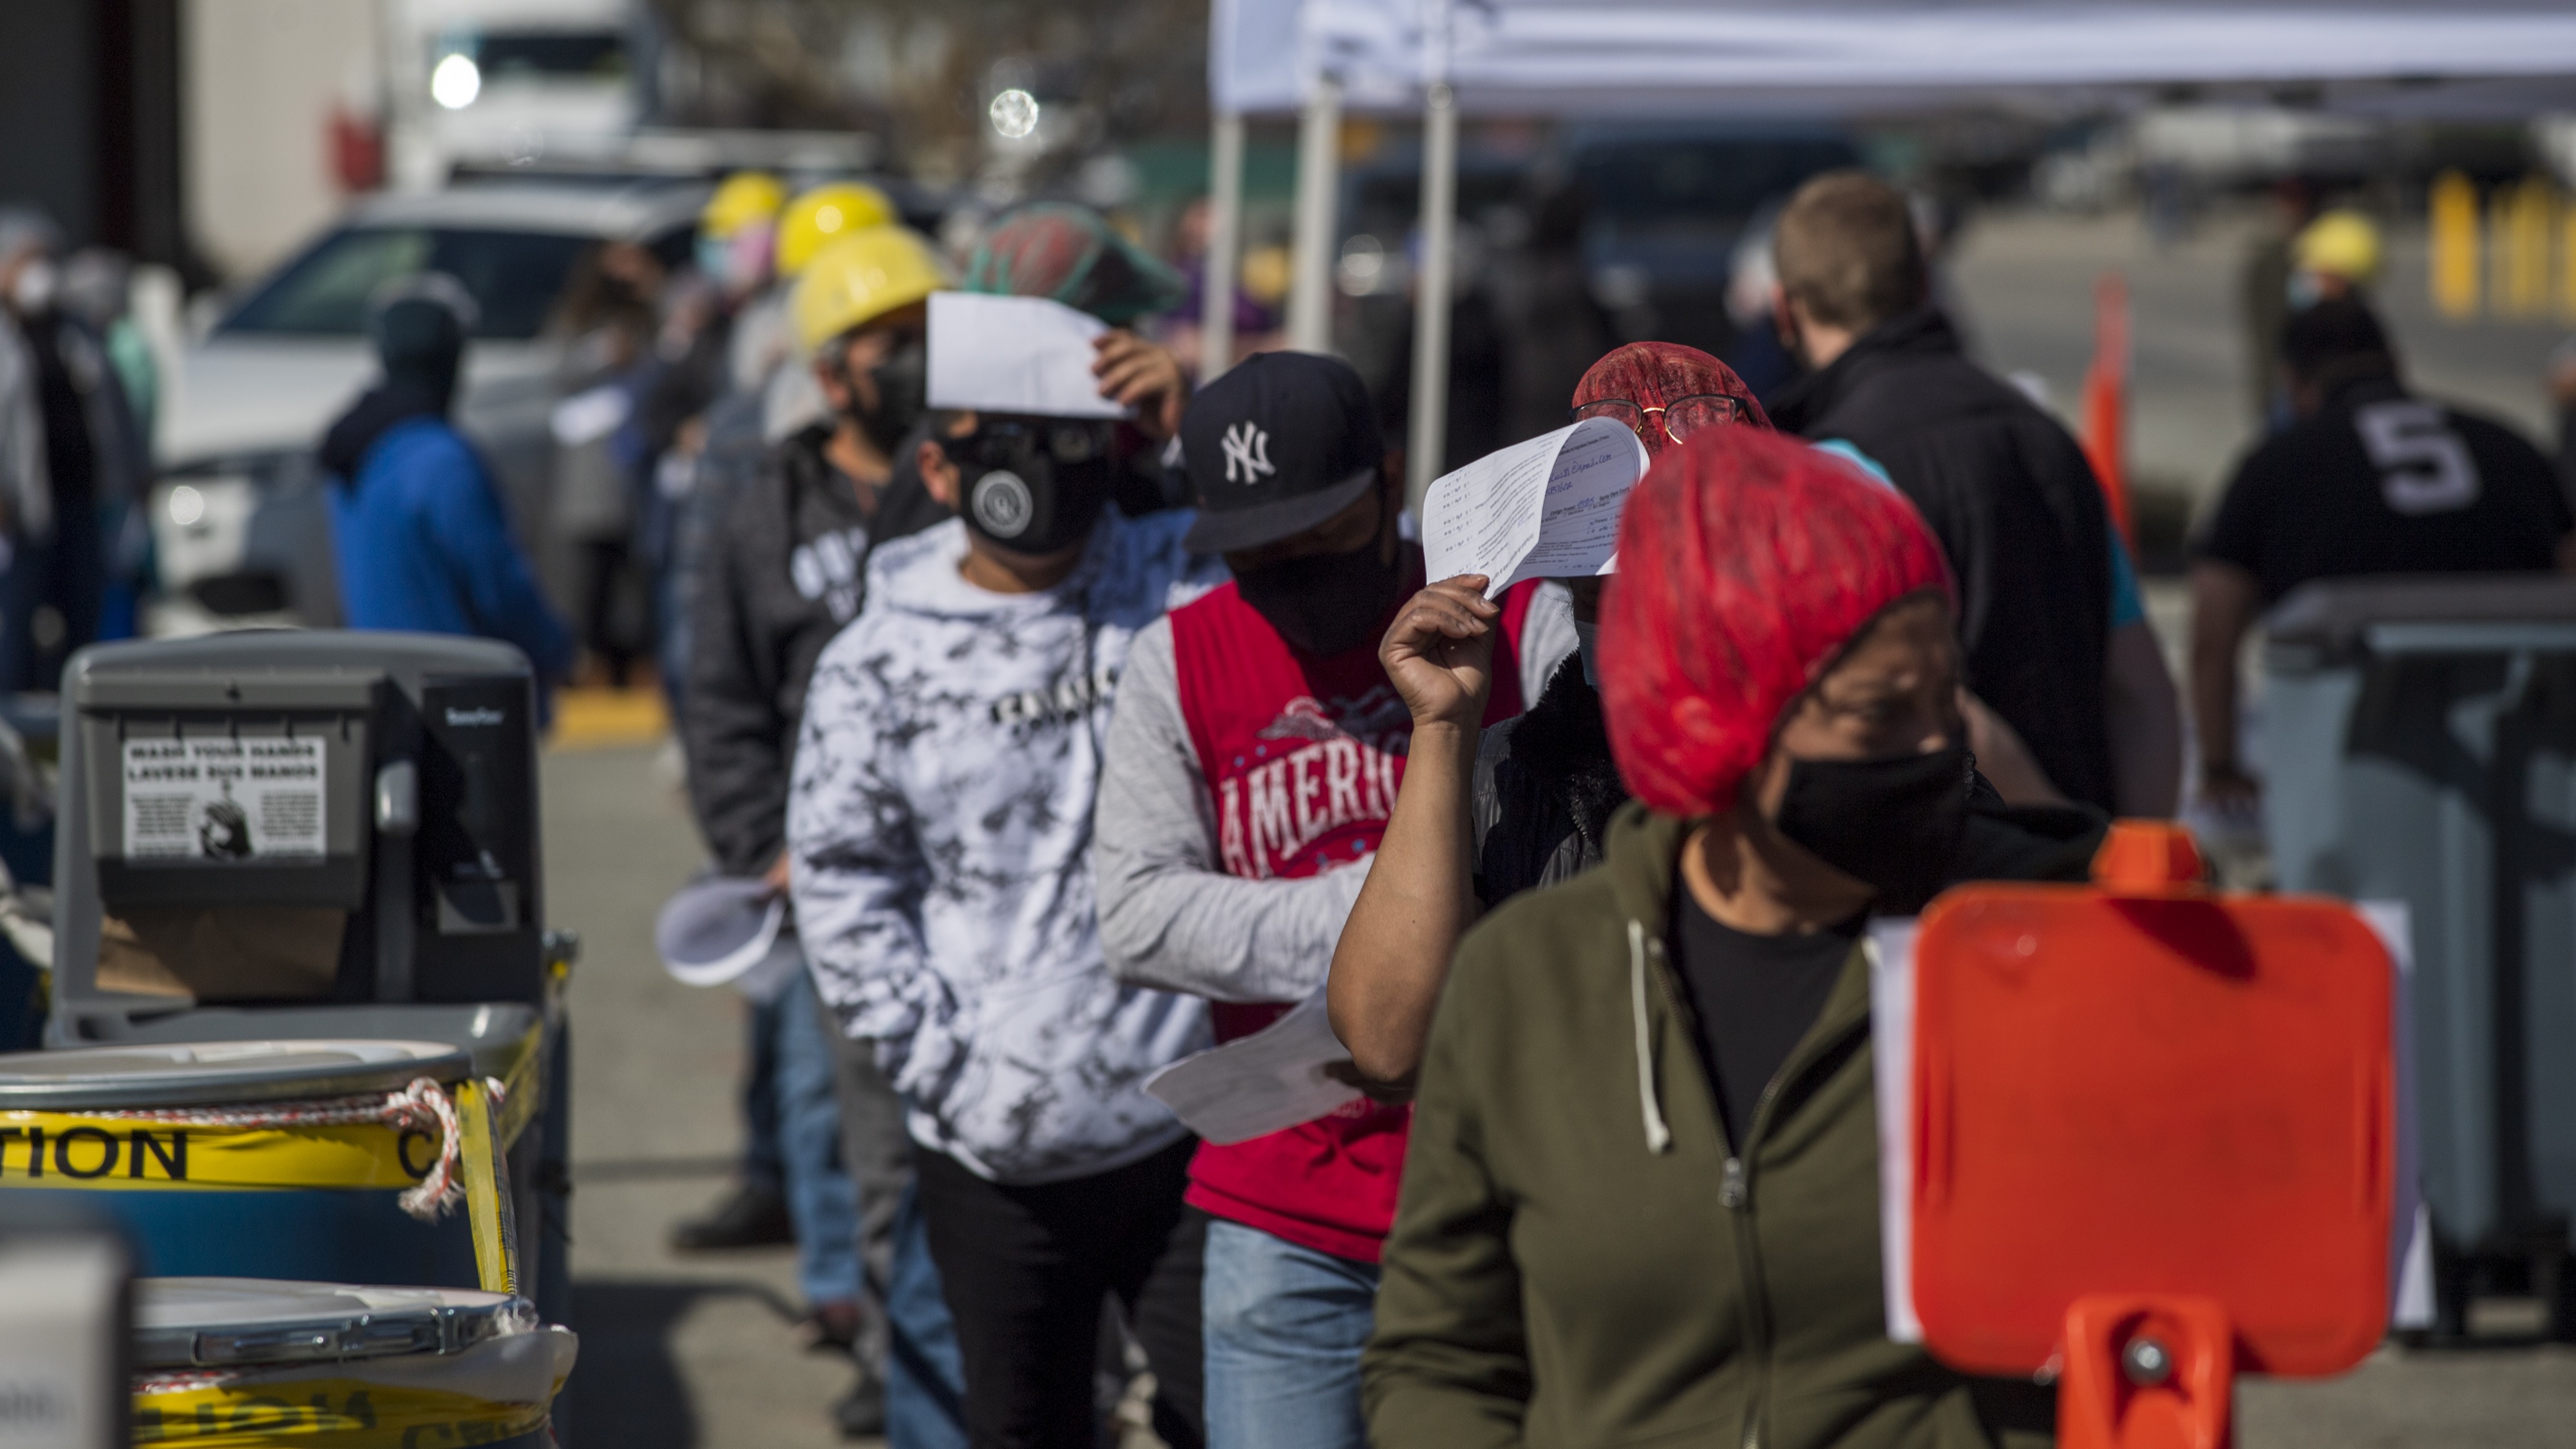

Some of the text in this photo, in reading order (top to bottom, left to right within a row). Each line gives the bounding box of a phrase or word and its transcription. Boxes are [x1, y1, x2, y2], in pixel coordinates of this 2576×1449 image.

[1221, 420, 1276, 485] NY
[2354, 401, 2481, 515] 5
[131, 746, 185, 759] WASH
[251, 744, 315, 757] HANDS
[251, 765, 316, 779] MANOS
